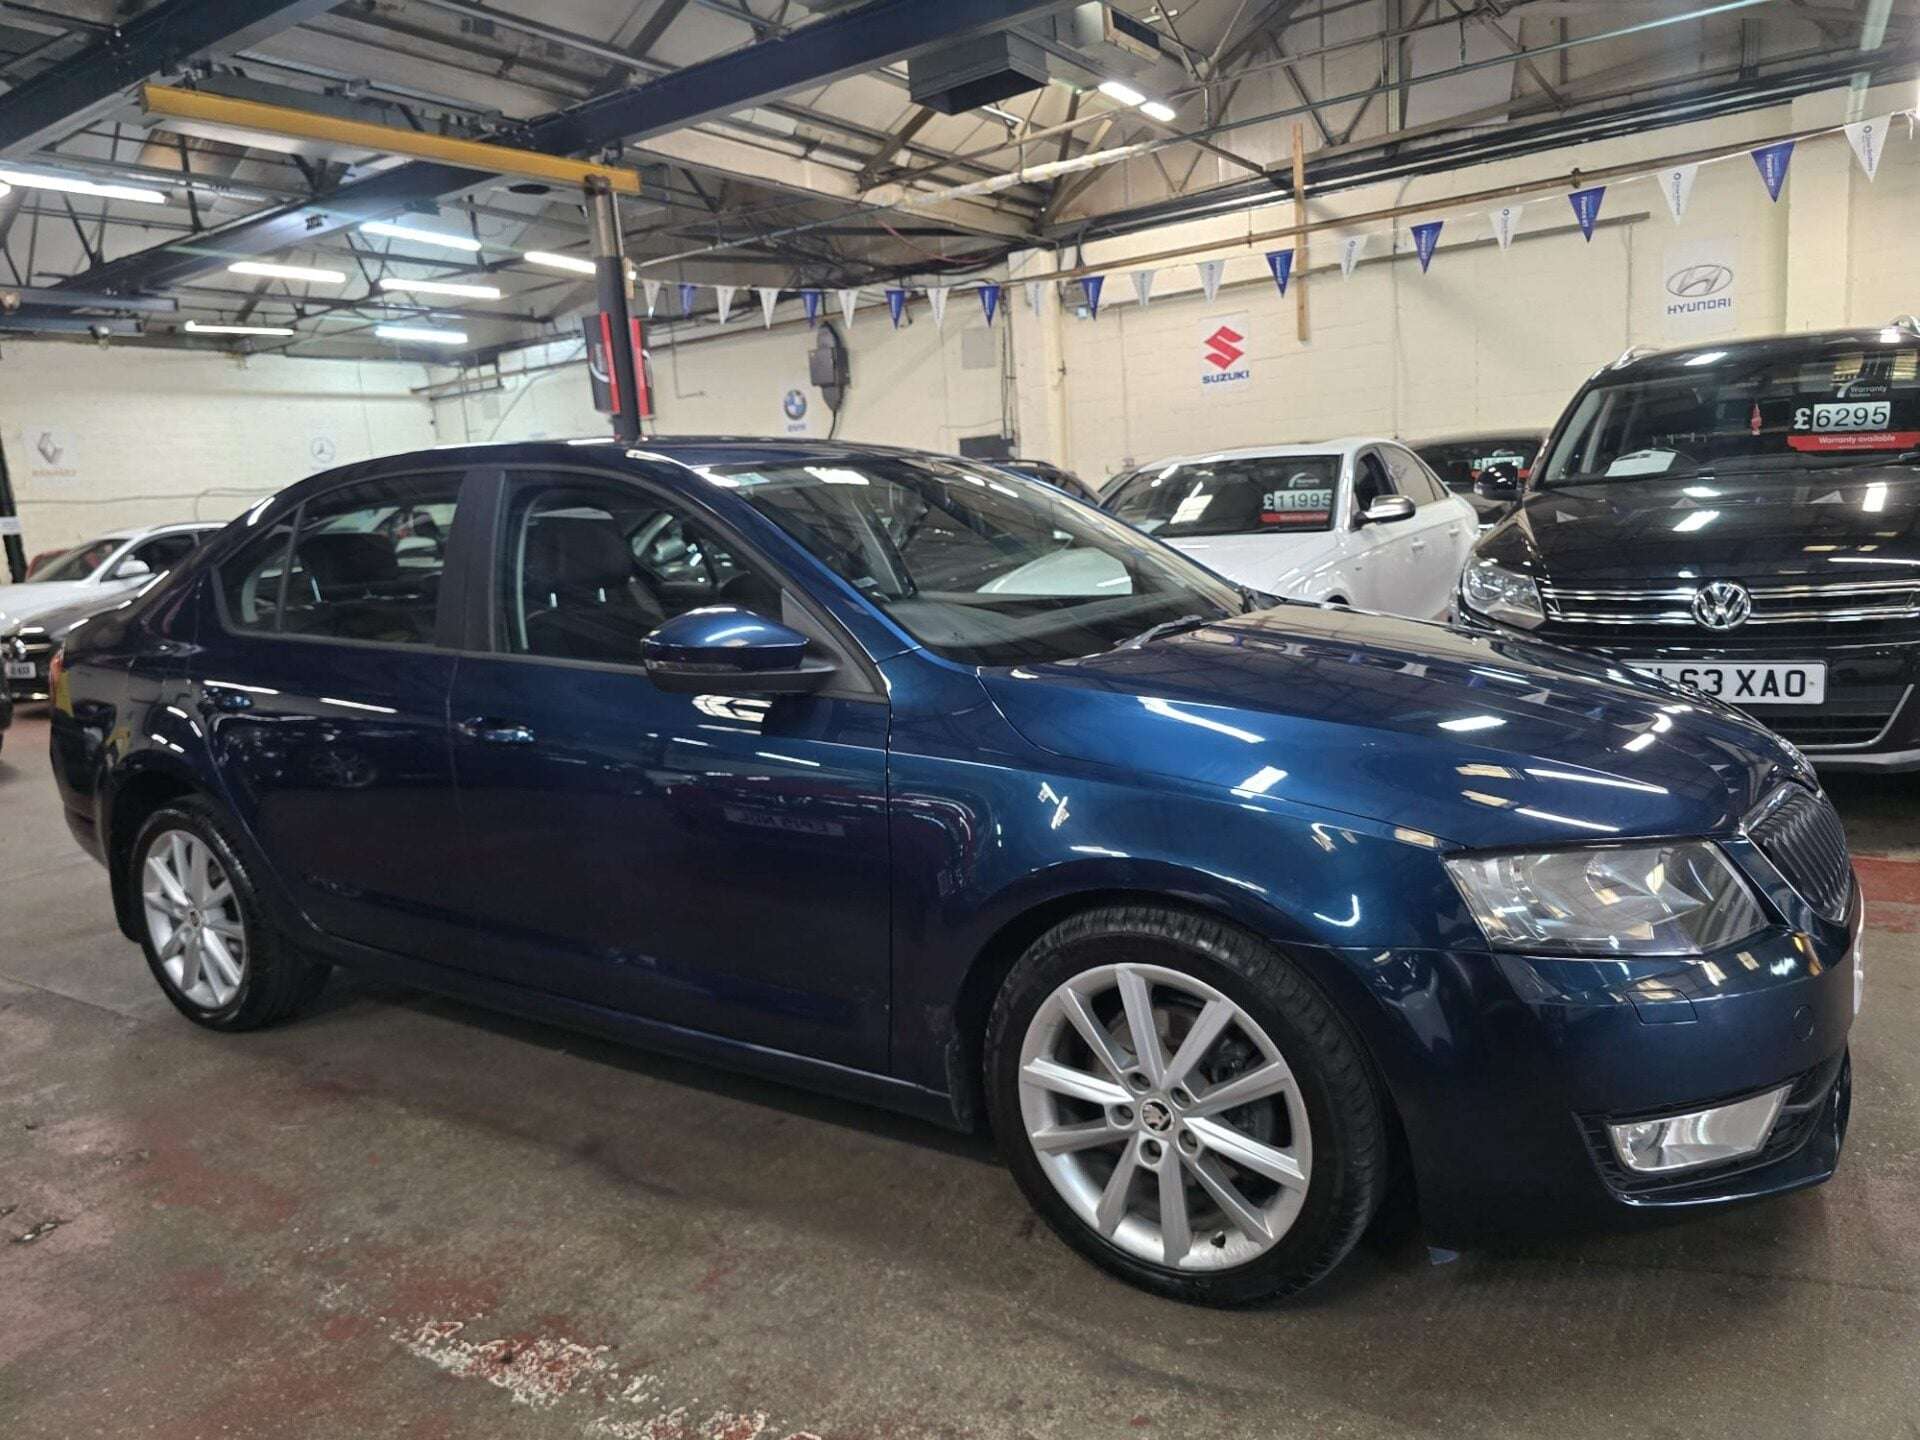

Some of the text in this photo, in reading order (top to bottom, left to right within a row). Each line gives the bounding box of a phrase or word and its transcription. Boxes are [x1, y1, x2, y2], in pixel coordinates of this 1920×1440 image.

[1667, 298, 1732, 314] HYUNDAI
[1202, 370, 1250, 384] SUZUKI
[1793, 405, 1888, 430] £6295
[1819, 433, 1895, 445] Warranty available
[1263, 492, 1330, 510] £11995
[1643, 668, 1806, 697] 63 XAO
